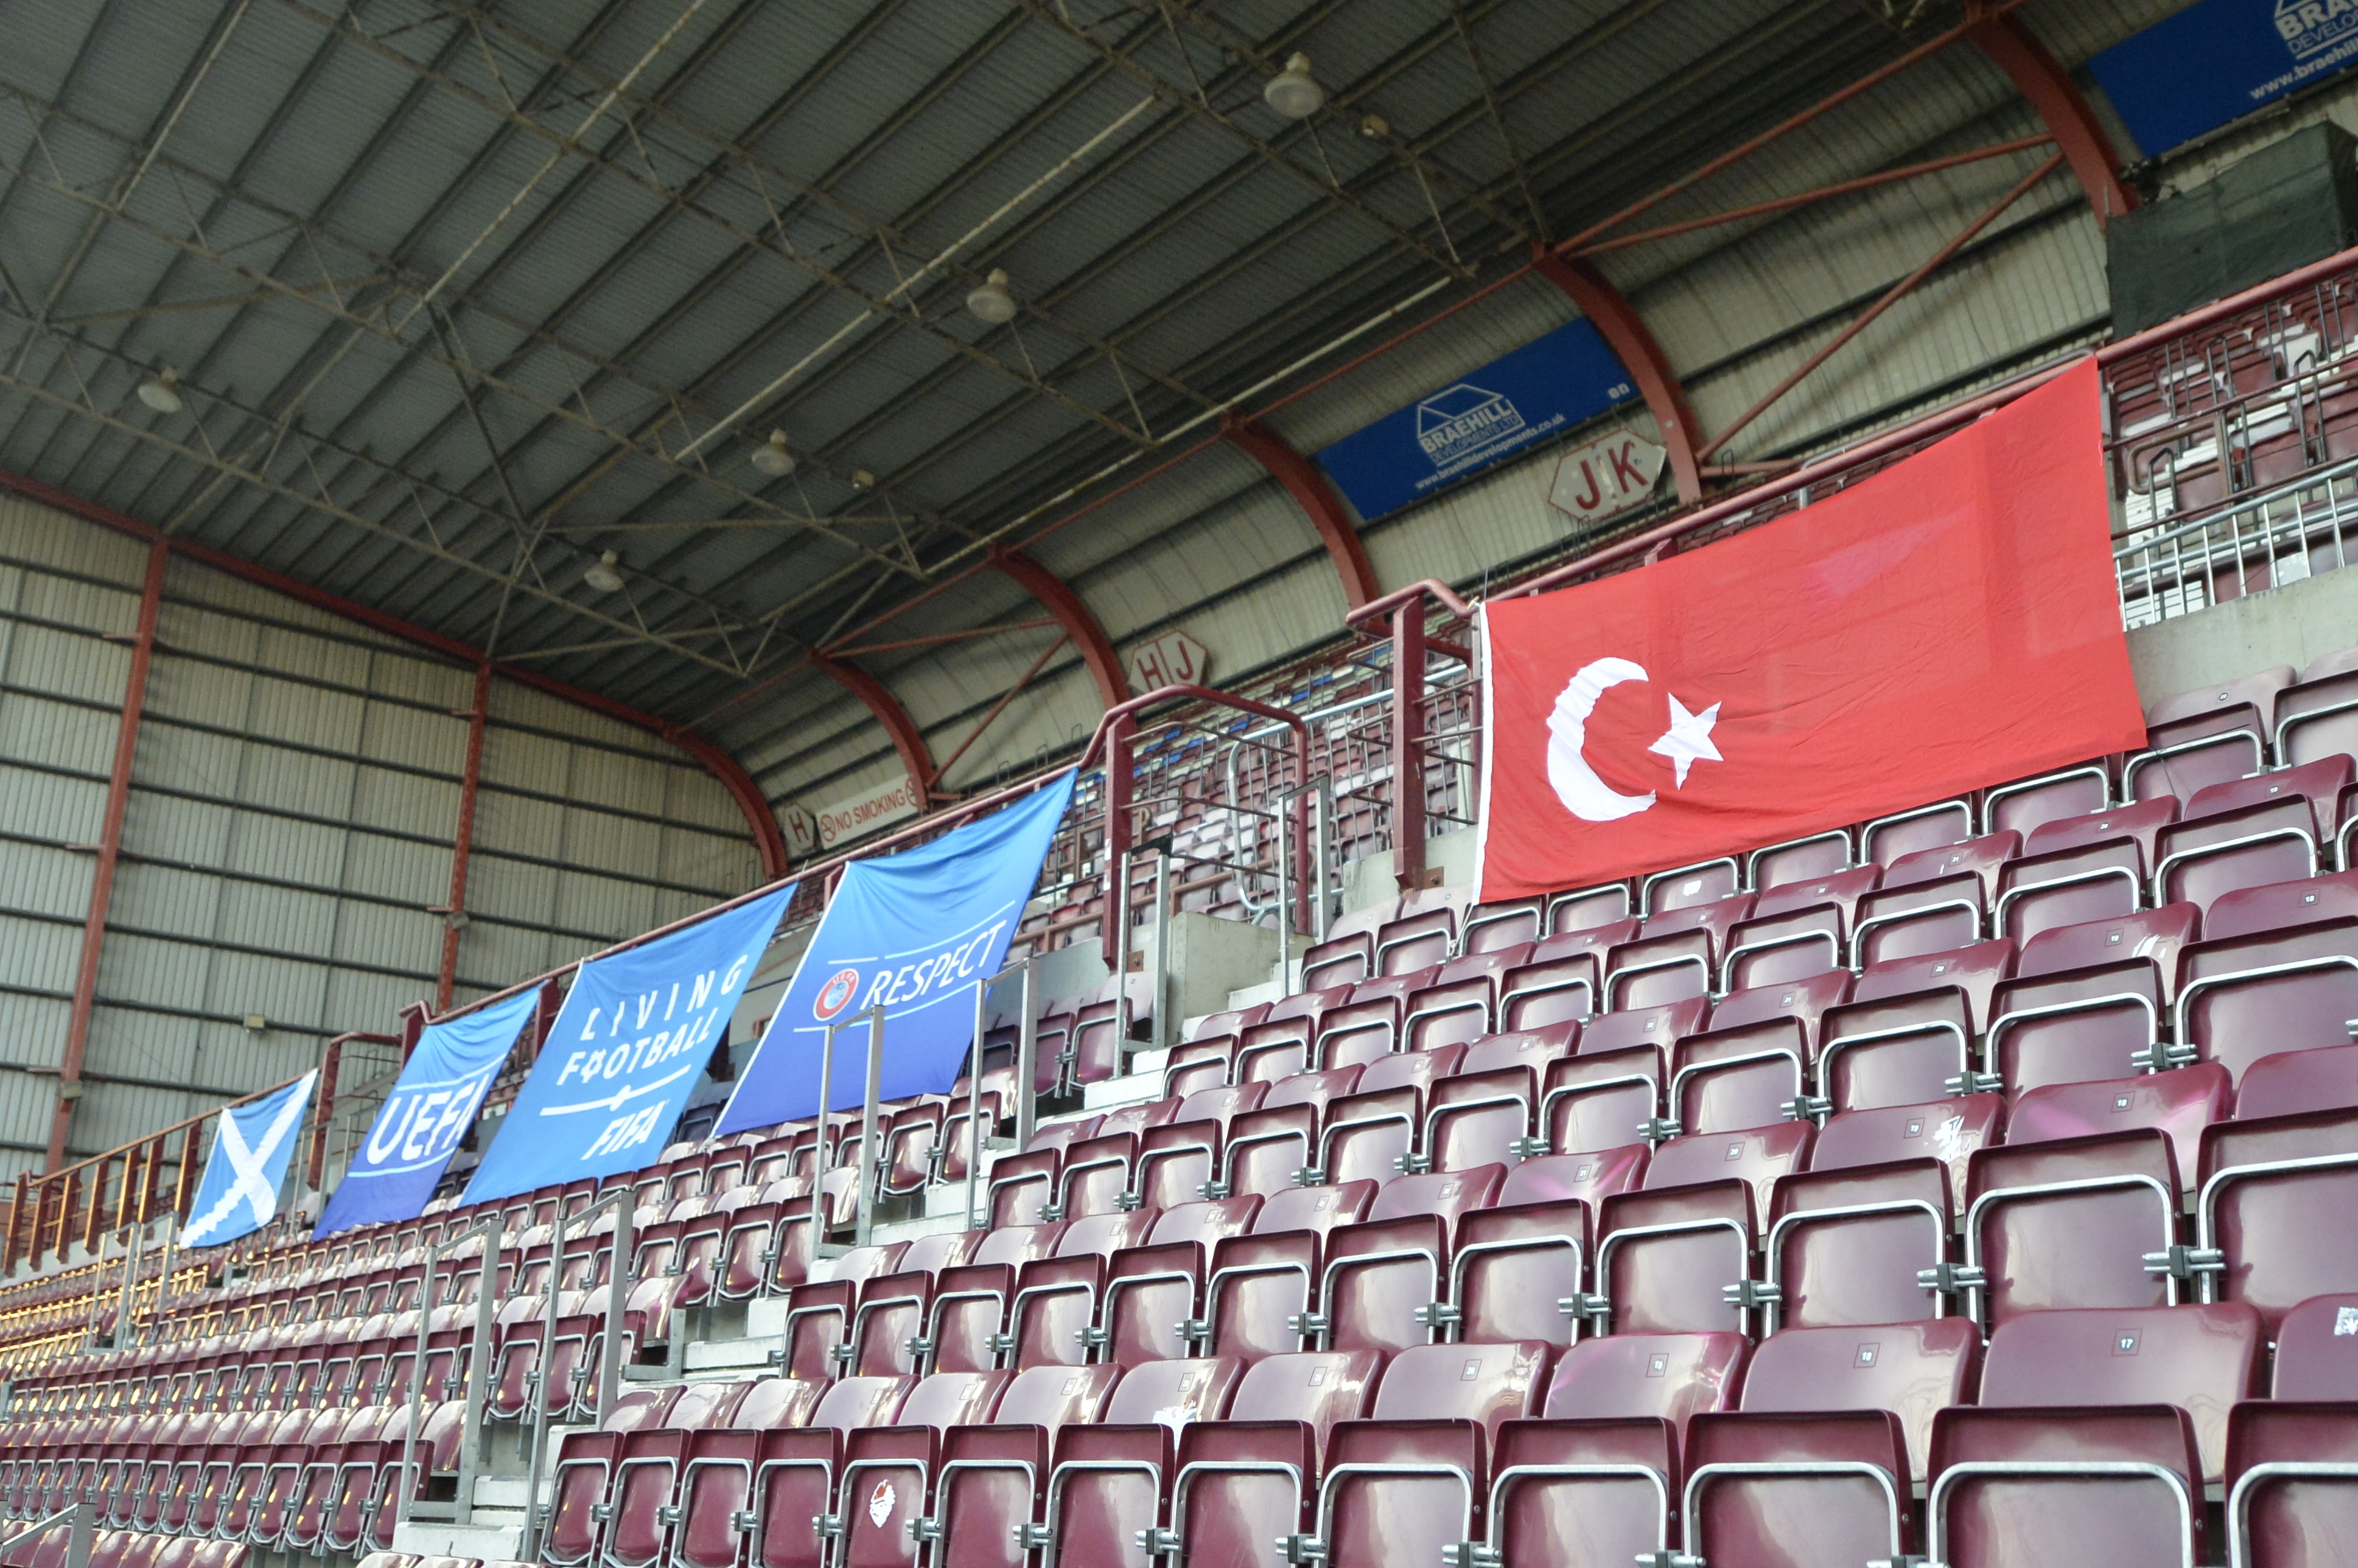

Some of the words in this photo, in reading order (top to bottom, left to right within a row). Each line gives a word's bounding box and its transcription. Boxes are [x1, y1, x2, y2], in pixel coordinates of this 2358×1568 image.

[2275, 0, 2358, 41] BRA
[1415, 413, 1567, 490] www.braehilldevelopments.co.uk
[1419, 402, 1512, 454] BRAEHILL
[1431, 424, 1500, 462] DEVELOPMENTS
[1499, 415, 1519, 430] LTD
[1575, 460, 1601, 510] J
[1607, 439, 1649, 494] K
[1136, 652, 1166, 692] H
[1175, 640, 1194, 681] J
[788, 811, 810, 843] H
[834, 811, 853, 832] NO
[853, 788, 906, 825] SMOKING
[859, 920, 1007, 1011] RESPECT
[579, 954, 749, 1041] LIVING
[556, 1007, 719, 1086] FOOTBALL
[366, 1073, 490, 1165] UEFA
[2116, 1098, 2128, 1107] 18
[580, 1099, 668, 1161] FIFA
[1861, 1351, 1873, 1362] 18
[2120, 1337, 2135, 1349] 17
